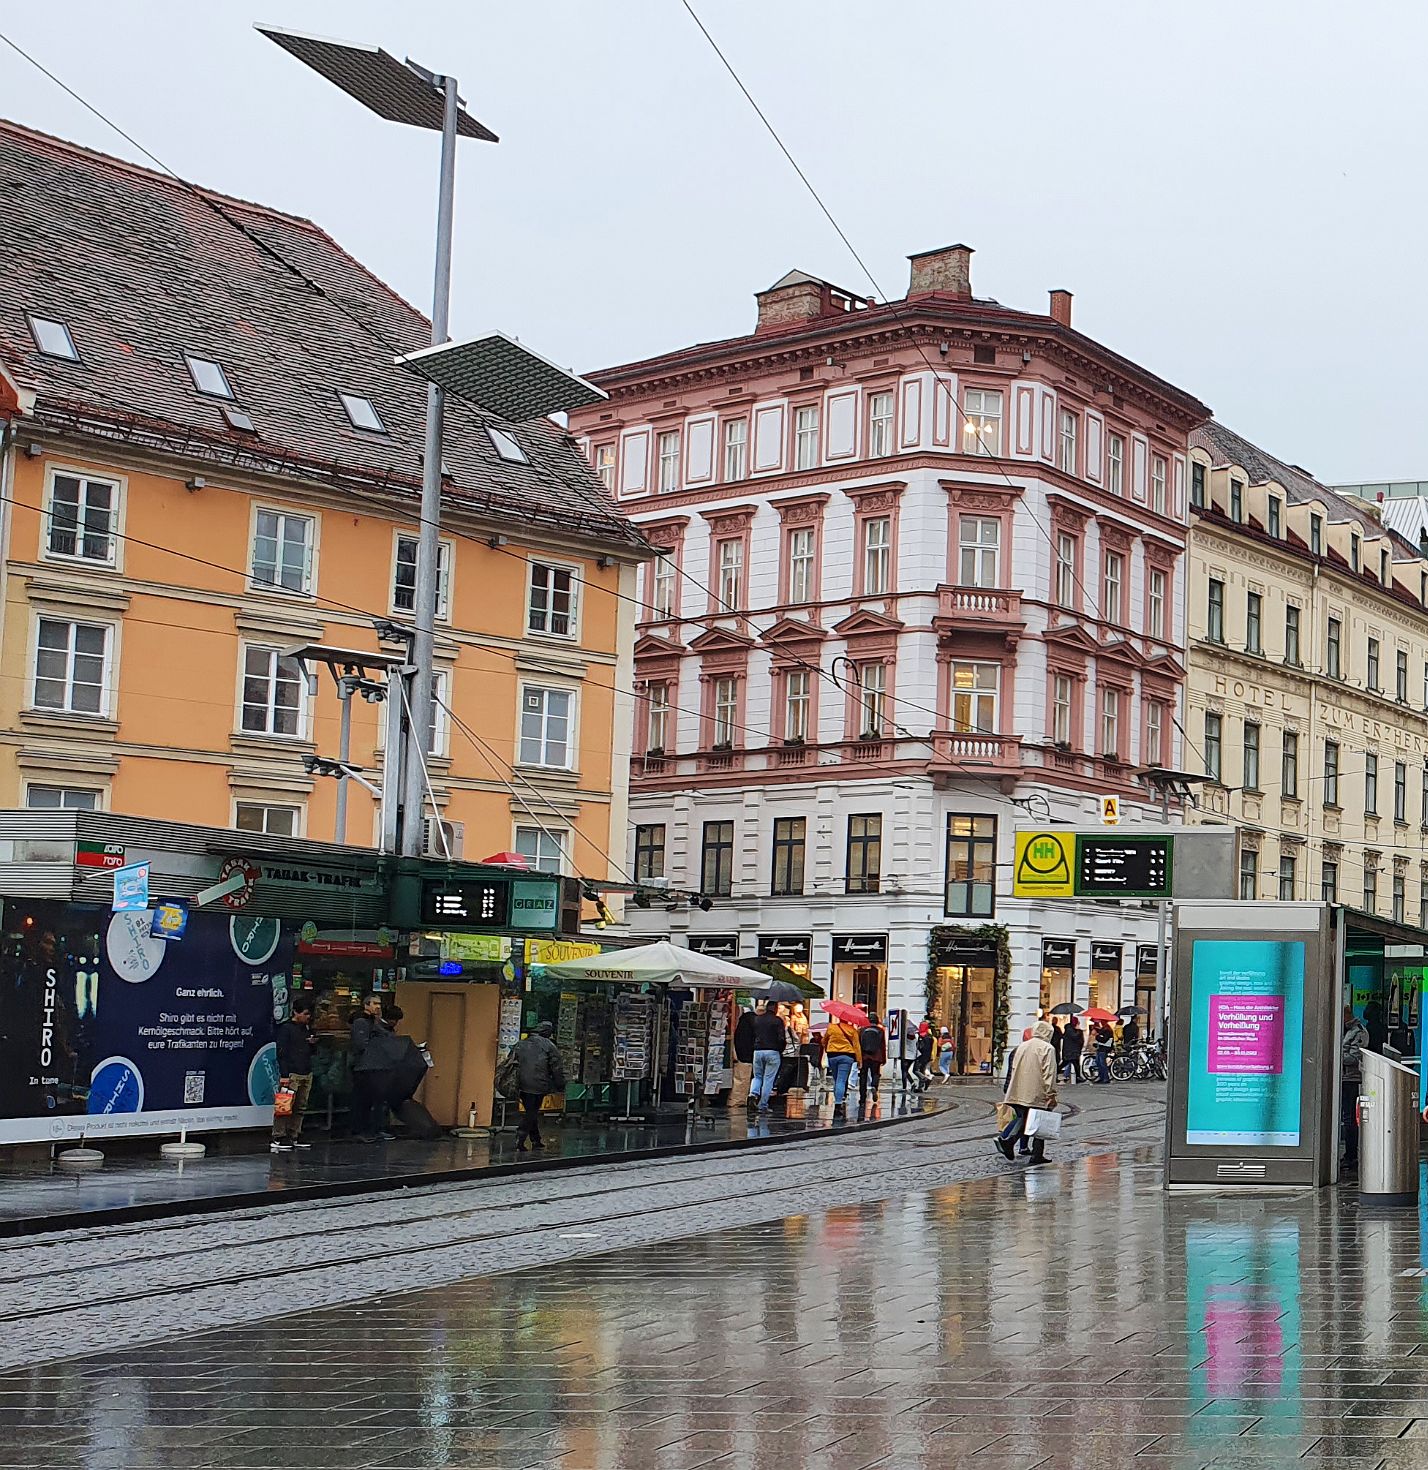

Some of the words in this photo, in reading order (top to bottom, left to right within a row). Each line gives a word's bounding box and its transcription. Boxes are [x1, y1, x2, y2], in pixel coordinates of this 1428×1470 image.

[1215, 675, 1292, 711] HOTEL
[1320, 704, 1354, 730] ZUM
[1105, 800, 1116, 817] A
[515, 899, 554, 909] GRAZ
[124, 913, 149, 970] SHIRO
[585, 970, 634, 979] SOUVENIR
[176, 987, 195, 997] Ganz
[197, 987, 224, 997] ehrlich.
[41, 968, 56, 1067] SHIRO
[160, 1012, 179, 1022] Shiro
[180, 1012, 194, 1024] gibt
[207, 1013, 224, 1022] nicht
[225, 1013, 237, 1022] mit
[1218, 1012, 1257, 1022] Verhüllung
[1259, 1013, 1273, 1021] und
[207, 1026, 223, 1035] Bitte
[225, 1026, 239, 1035] hört
[148, 1041, 164, 1049] eure
[167, 1039, 207, 1048] Trafikanten
[219, 1039, 244, 1050] fragen!
[29, 1076, 38, 1085] In
[102, 1069, 130, 1114] SHIR
